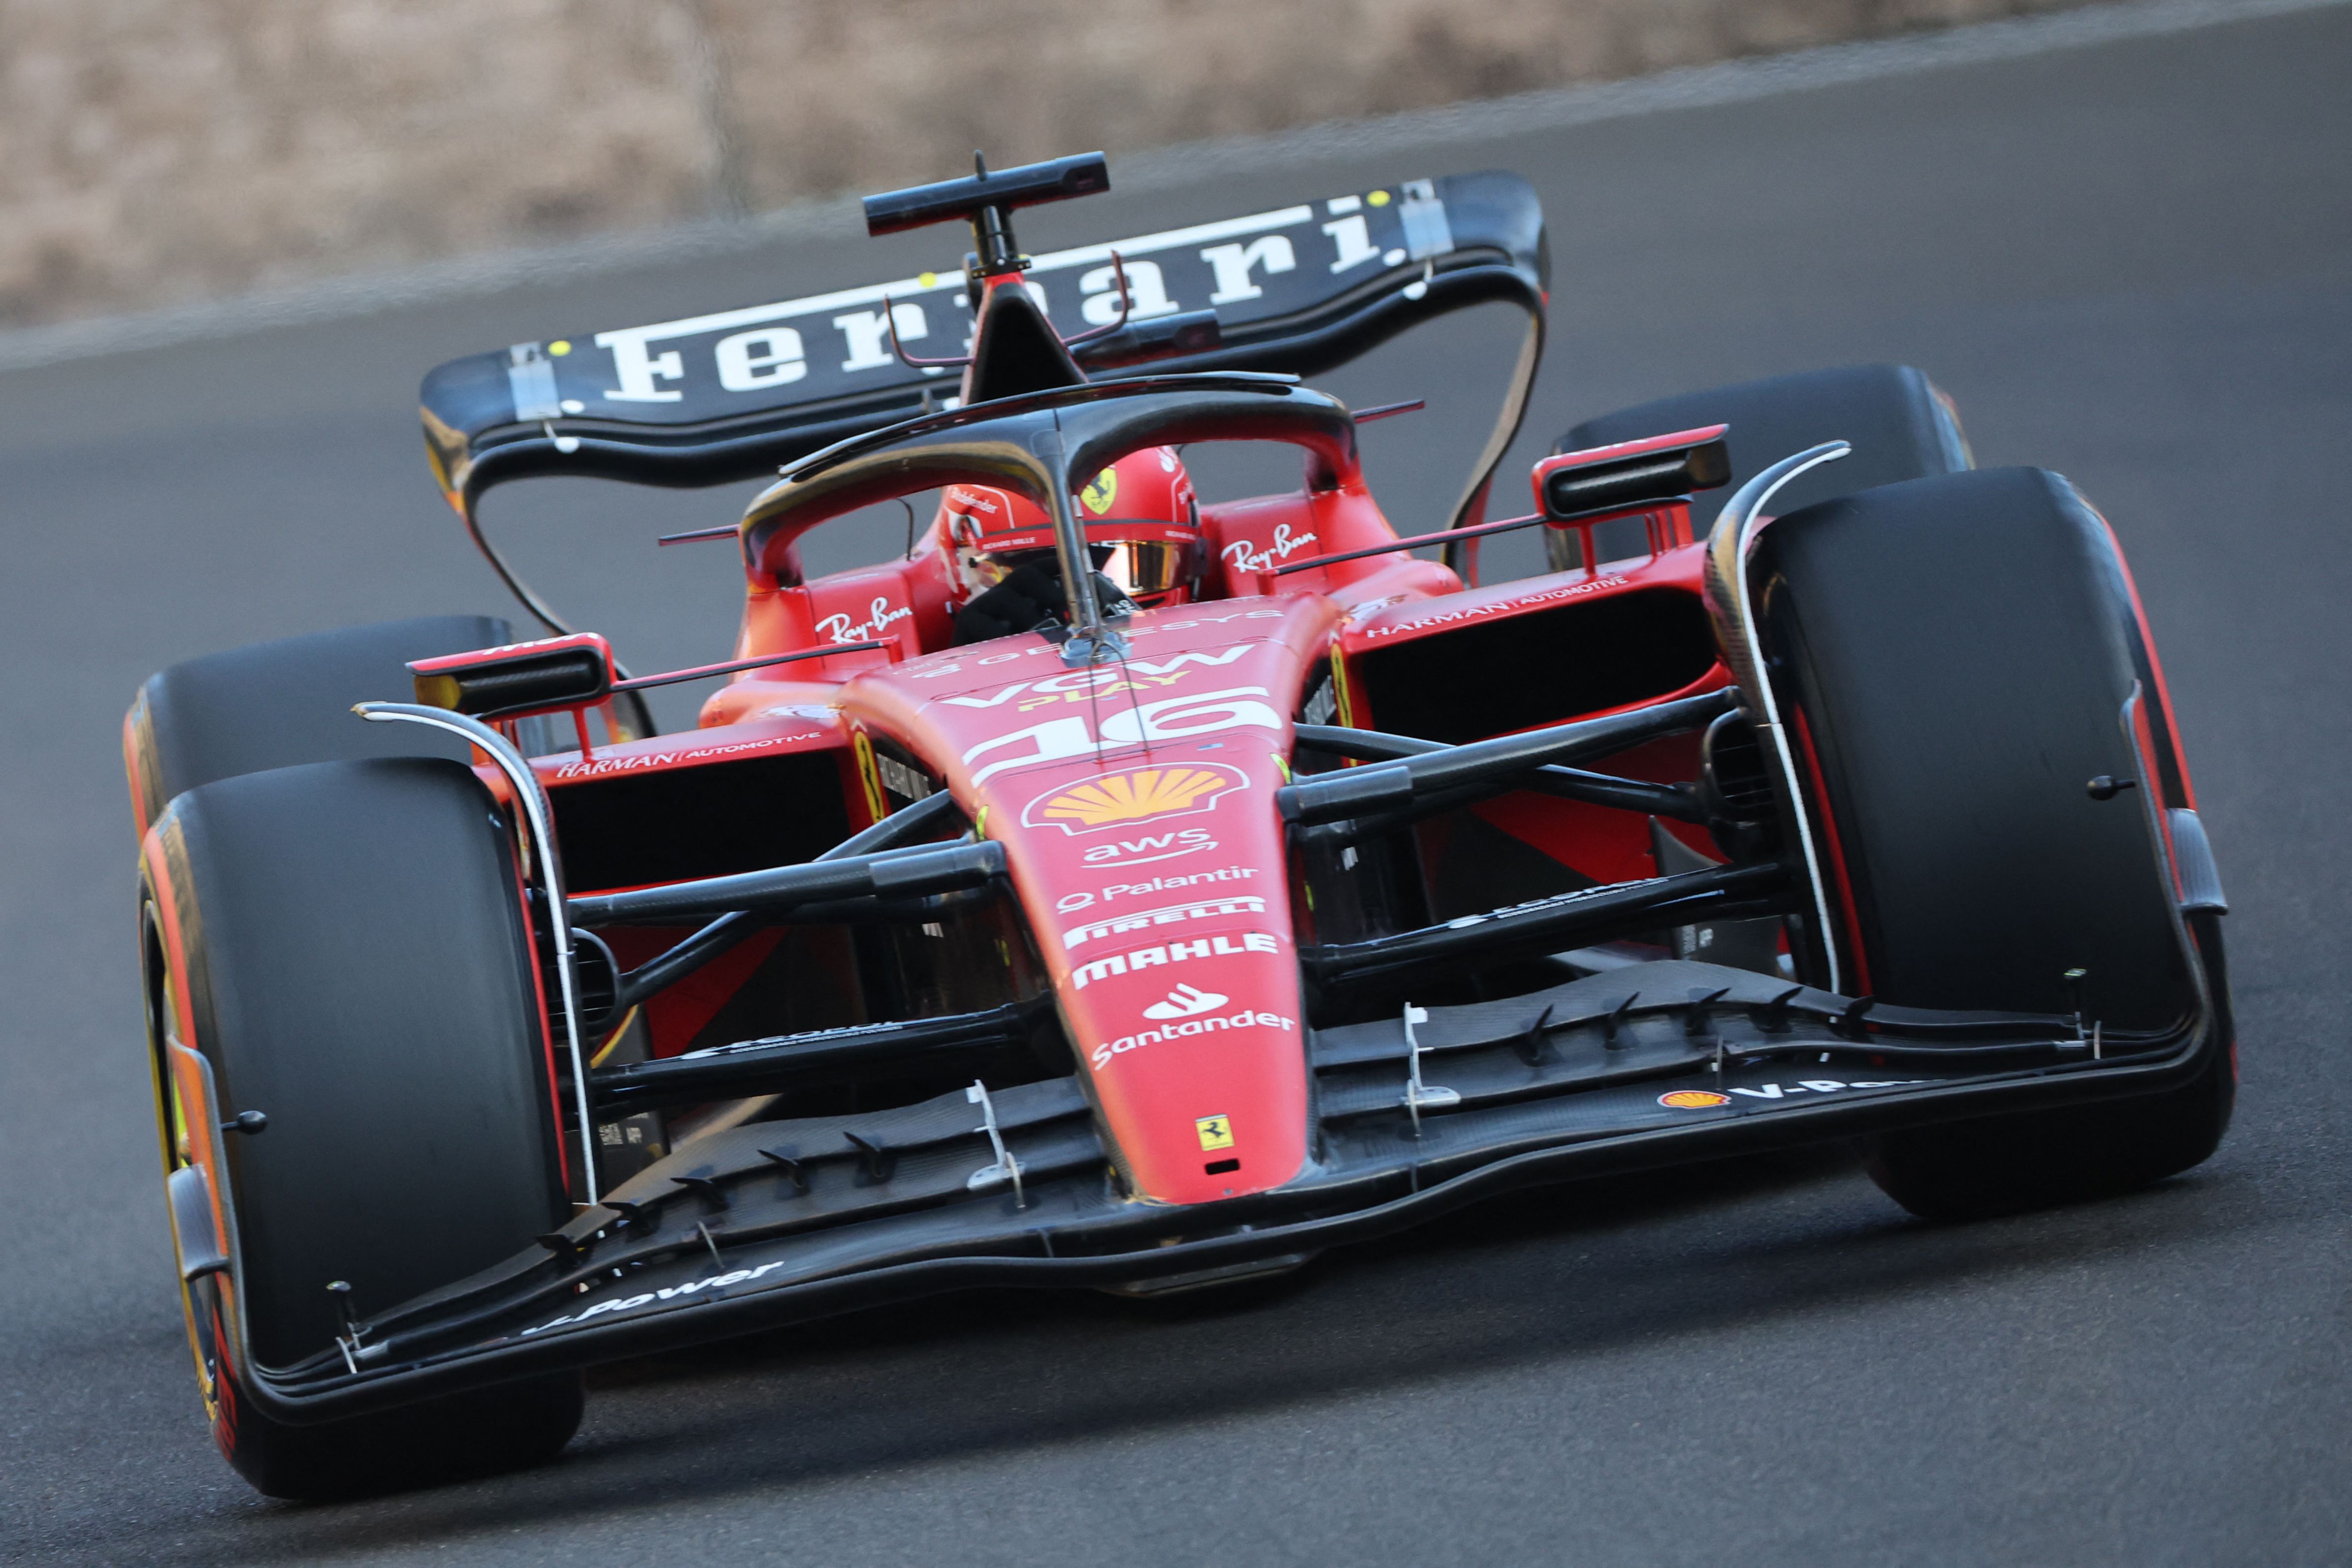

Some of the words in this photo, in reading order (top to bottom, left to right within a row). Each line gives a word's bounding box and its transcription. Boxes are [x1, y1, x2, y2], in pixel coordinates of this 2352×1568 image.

[1220, 523, 1317, 573] Ray-Ban
[815, 597, 913, 643] Ray-Ban
[1367, 601, 1510, 638] HARMAN
[1520, 575, 1629, 605] AUTOMOTIVE
[977, 609, 1285, 666] GEESYS
[939, 644, 1257, 709] VGW
[1017, 670, 1192, 712] PLAY
[556, 752, 674, 778] HARMAN
[686, 731, 821, 759] AUTOMOTIVE
[962, 686, 1284, 788] 16
[1083, 827, 1213, 862] aws
[1104, 866, 1259, 901] Palantir
[1063, 896, 1266, 951] PIRELLI
[1072, 932, 1278, 990] MAHLE
[1091, 1009, 1295, 1071] Santander
